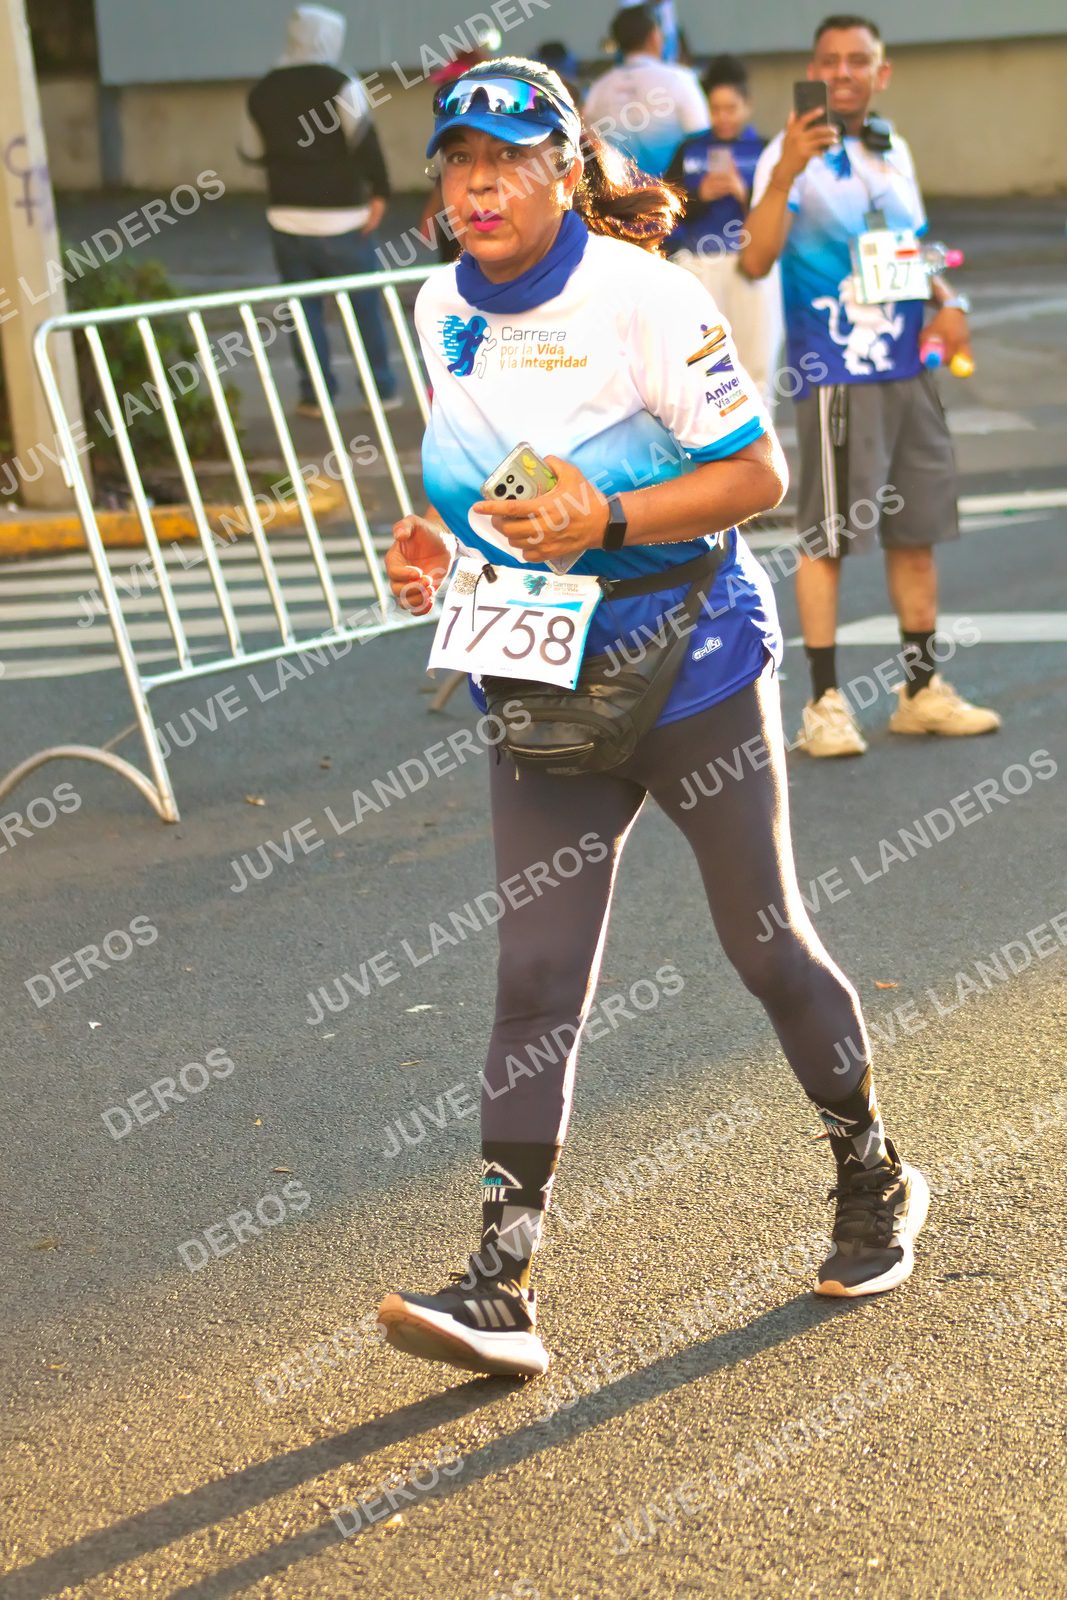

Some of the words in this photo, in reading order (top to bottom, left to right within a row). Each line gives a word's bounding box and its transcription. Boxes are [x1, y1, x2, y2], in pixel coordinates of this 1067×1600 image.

[501, 326, 566, 341] Carrera
[501, 345, 519, 357] por
[522, 345, 532, 355] la
[537, 344, 564, 355] Vida
[507, 358, 517, 369] la
[520, 355, 588, 371] Integridad
[442, 605, 576, 666] 1758
